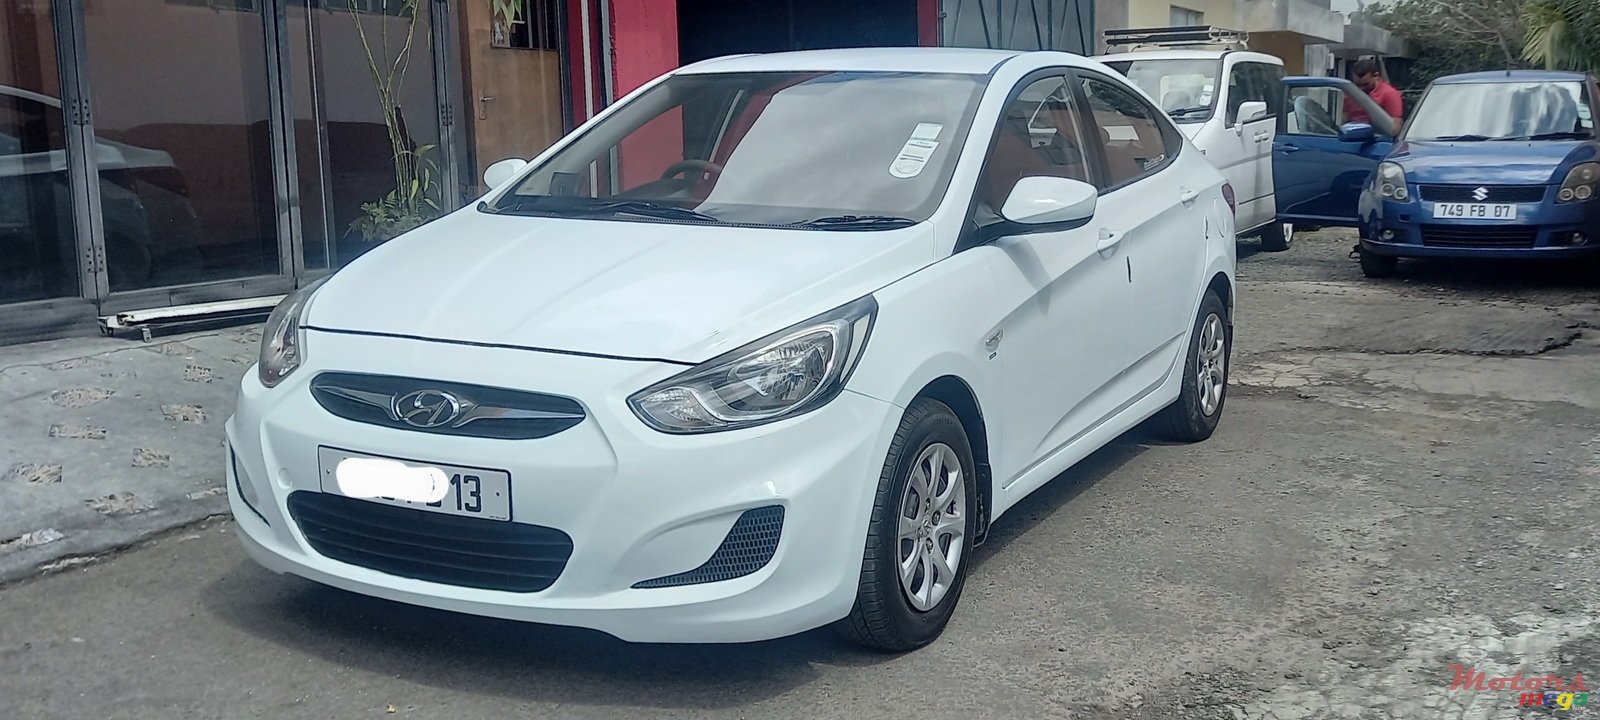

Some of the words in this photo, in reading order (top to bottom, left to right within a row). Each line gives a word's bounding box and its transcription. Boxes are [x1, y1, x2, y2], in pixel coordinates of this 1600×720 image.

[1440, 204, 1463, 217] 749
[1470, 204, 1486, 217] FB
[1494, 205, 1511, 218] 07
[450, 473, 482, 513] 13
